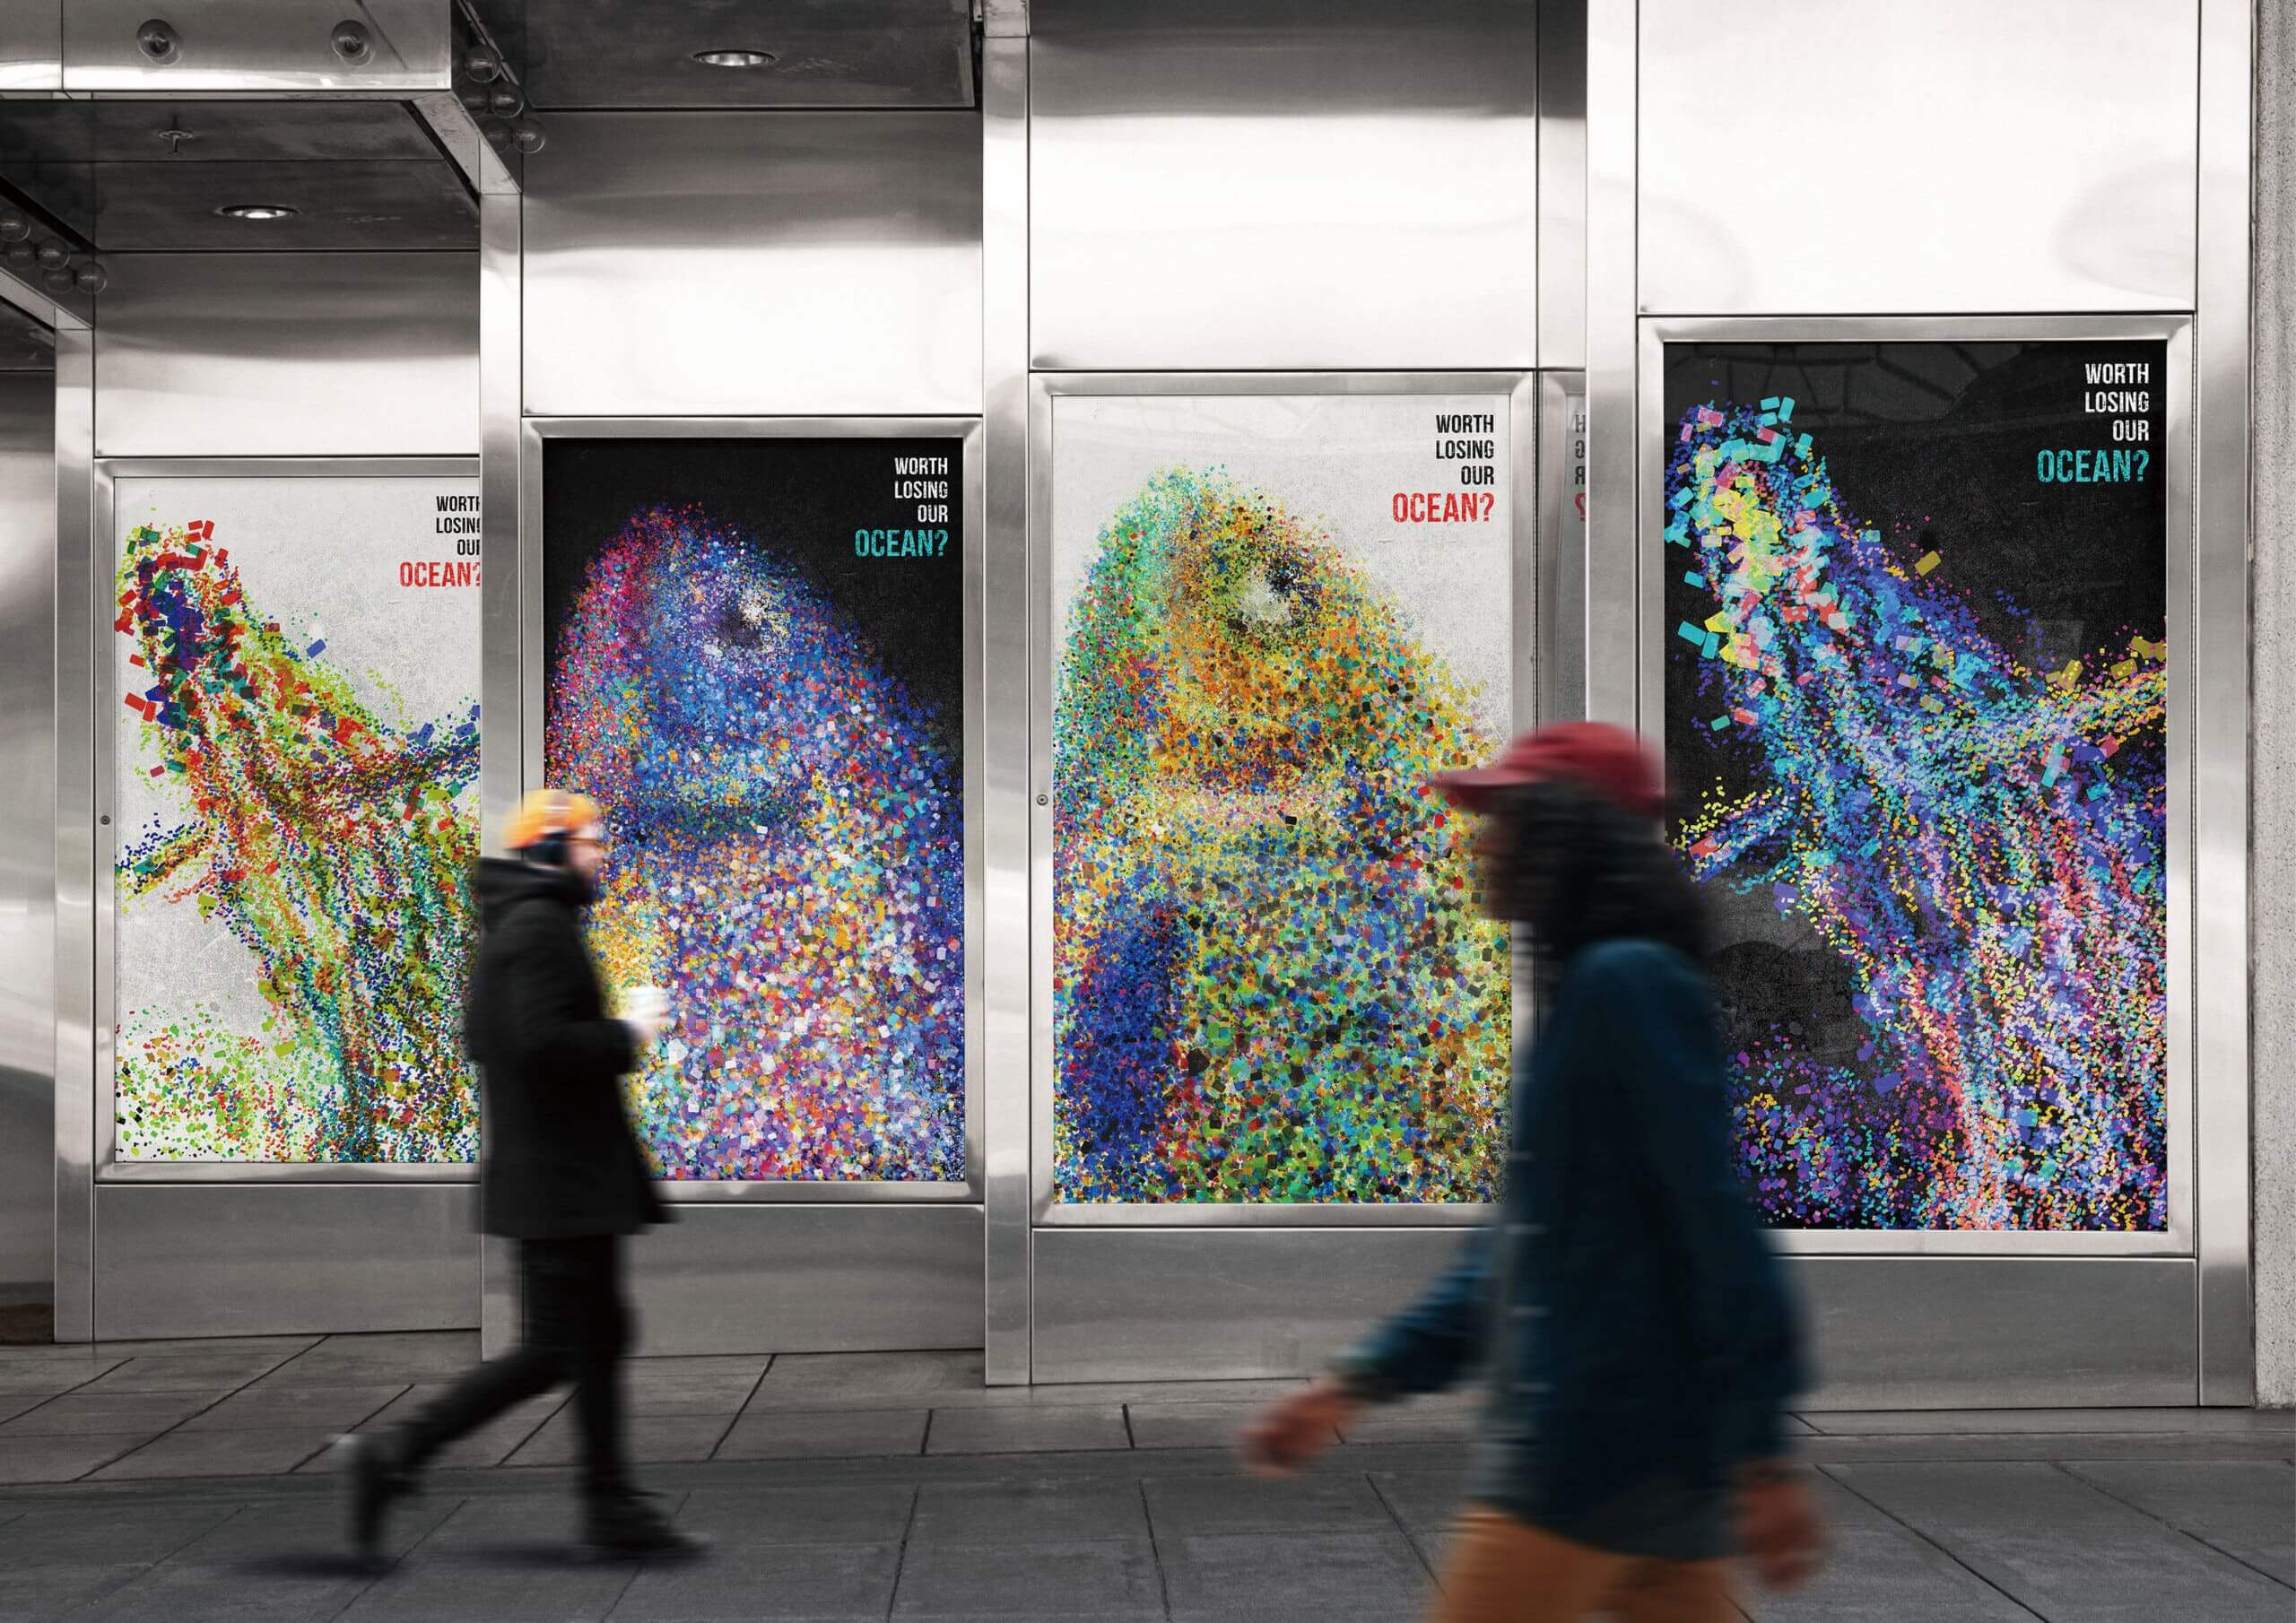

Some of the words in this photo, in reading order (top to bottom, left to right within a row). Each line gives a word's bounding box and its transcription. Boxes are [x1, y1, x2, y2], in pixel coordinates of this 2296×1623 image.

[2084, 363, 2150, 385] WORTH
[2084, 391, 2150, 413] LOSING
[1436, 414, 1494, 433] WORTH
[2112, 420, 2150, 442] OUR
[1436, 440, 1494, 459] LOSING
[894, 457, 948, 475] WORTH
[1461, 465, 1494, 485] OUR
[2037, 449, 2150, 482] OCEAN?
[894, 481, 948, 499] LOSING
[918, 504, 948, 523] OUR
[1392, 493, 1495, 523] OCEAN?
[855, 529, 948, 557] OCEAN?
